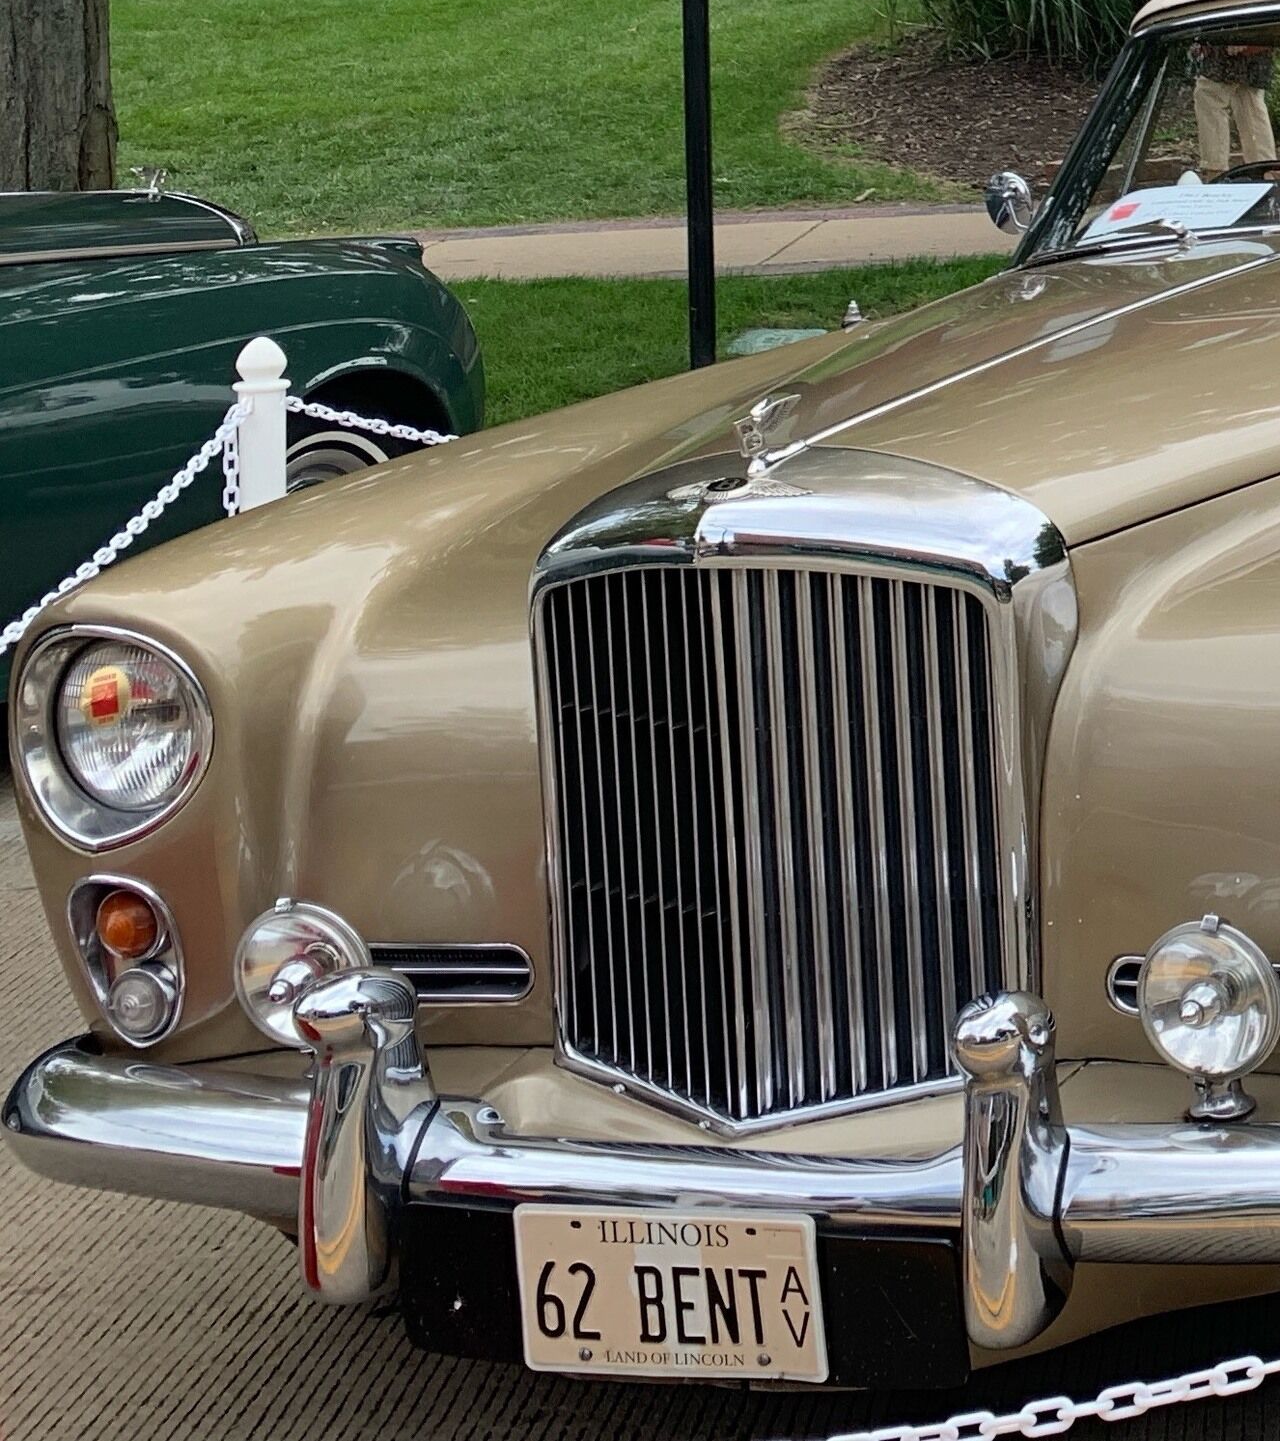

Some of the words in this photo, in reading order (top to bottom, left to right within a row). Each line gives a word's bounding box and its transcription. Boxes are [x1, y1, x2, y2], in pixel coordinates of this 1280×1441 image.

[599, 1220, 730, 1248] ILLINOIS
[536, 1261, 601, 1341] 62
[634, 1265, 767, 1345] BENT
[606, 1350, 648, 1364] LAND
[650, 1351, 670, 1365] OF
[674, 1353, 745, 1366] LINCOLN
